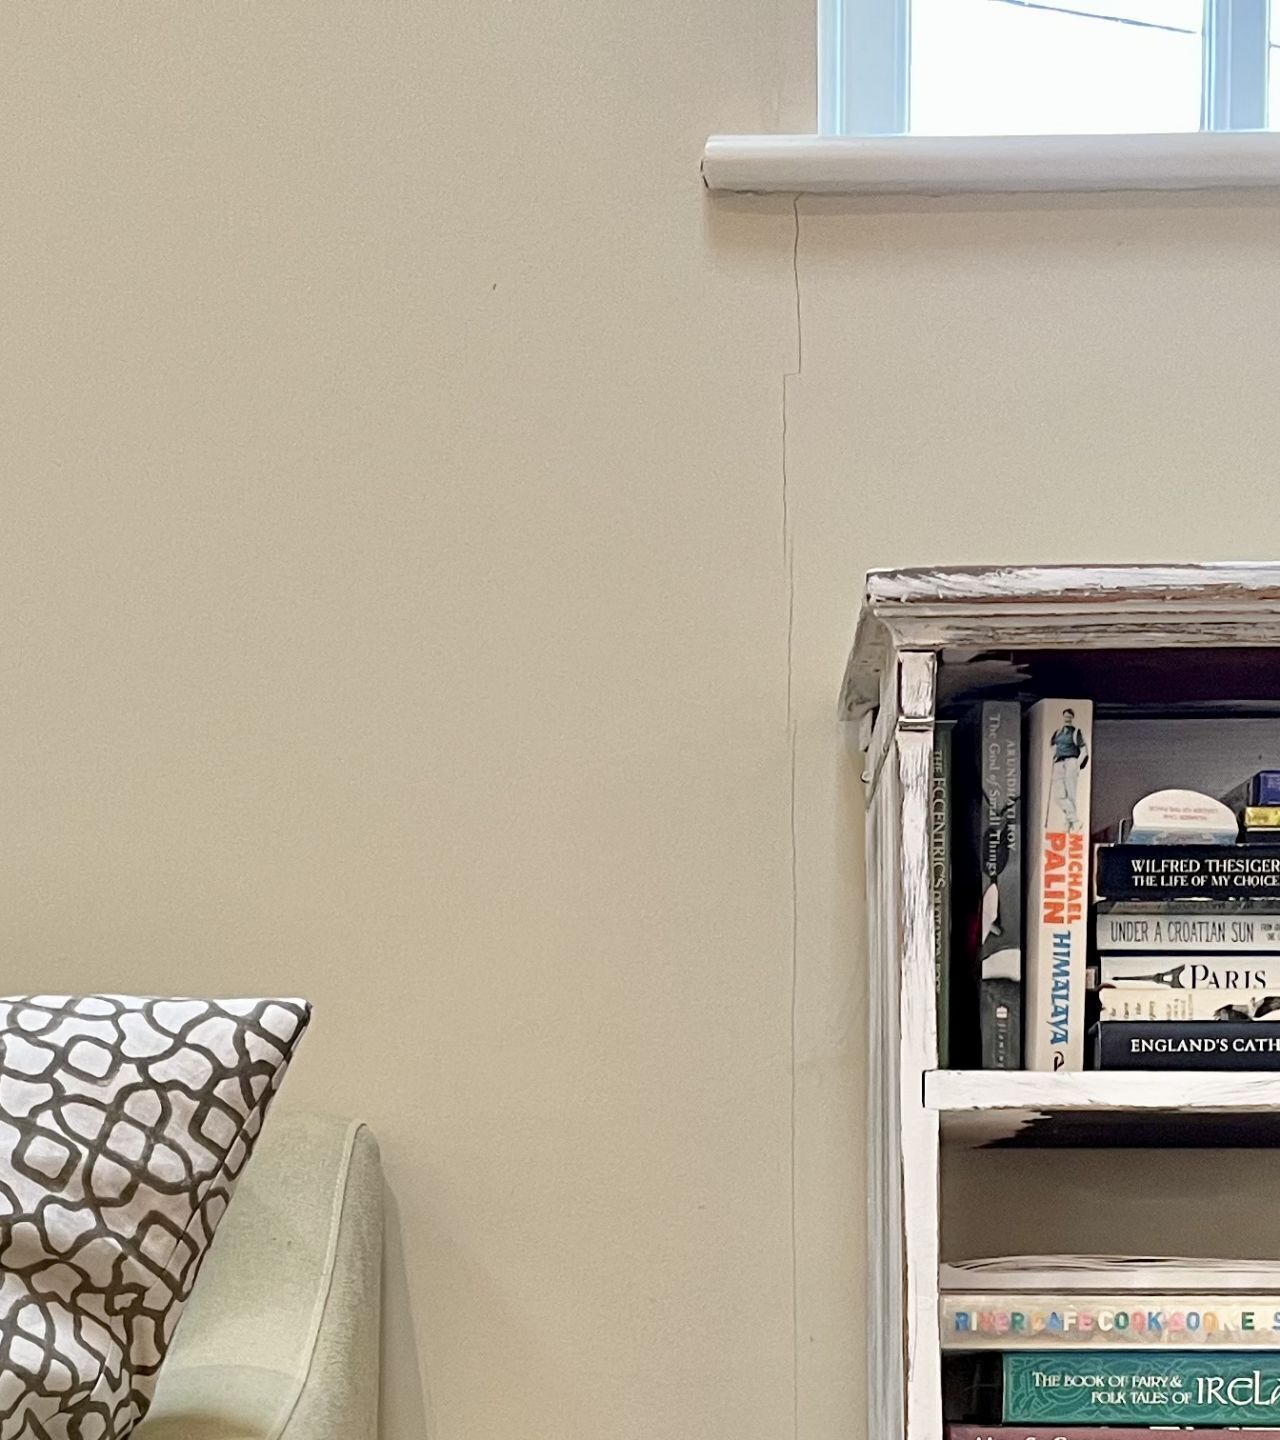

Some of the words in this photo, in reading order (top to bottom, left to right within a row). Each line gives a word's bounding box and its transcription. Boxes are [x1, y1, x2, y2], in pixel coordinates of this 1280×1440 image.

[989, 713, 1001, 739] The
[989, 742, 1001, 771] God
[987, 774, 1001, 787] of
[989, 789, 1001, 826] Small
[1006, 823, 1017, 851] ROY
[985, 829, 1002, 877] Things
[1043, 832, 1067, 924] PALIN
[1067, 833, 1083, 924] MICHAEL
[1131, 860, 1200, 874] WILFRED
[1204, 859, 1280, 874] THESIGER
[1132, 875, 1158, 886] THE
[1161, 875, 1189, 886] LIFE
[1191, 875, 1207, 886] OF
[1210, 875, 1231, 887] MY
[1233, 875, 1280, 886] CHOICE
[1111, 921, 1149, 943] UNDER
[1154, 921, 1163, 943] A
[1168, 921, 1226, 943] CROATIAN
[1231, 921, 1255, 943] SUN
[1046, 931, 1071, 1045] HIMALAYA
[1131, 1038, 1229, 1053] ENGLAND'S
[953, 1311, 1025, 1332] RIVER
[1031, 1311, 1095, 1332] CAFE
[1097, 1311, 1163, 1332] COOK
[1032, 1371, 1061, 1387] THE
[1064, 1373, 1104, 1387] BOOK
[1108, 1374, 1128, 1387] OF
[1131, 1374, 1168, 1388] FAIRY
[1169, 1374, 1183, 1388] &
[1091, 1390, 1126, 1404] FOLK
[1129, 1390, 1169, 1404] TALES
[1172, 1391, 1193, 1404] OF
